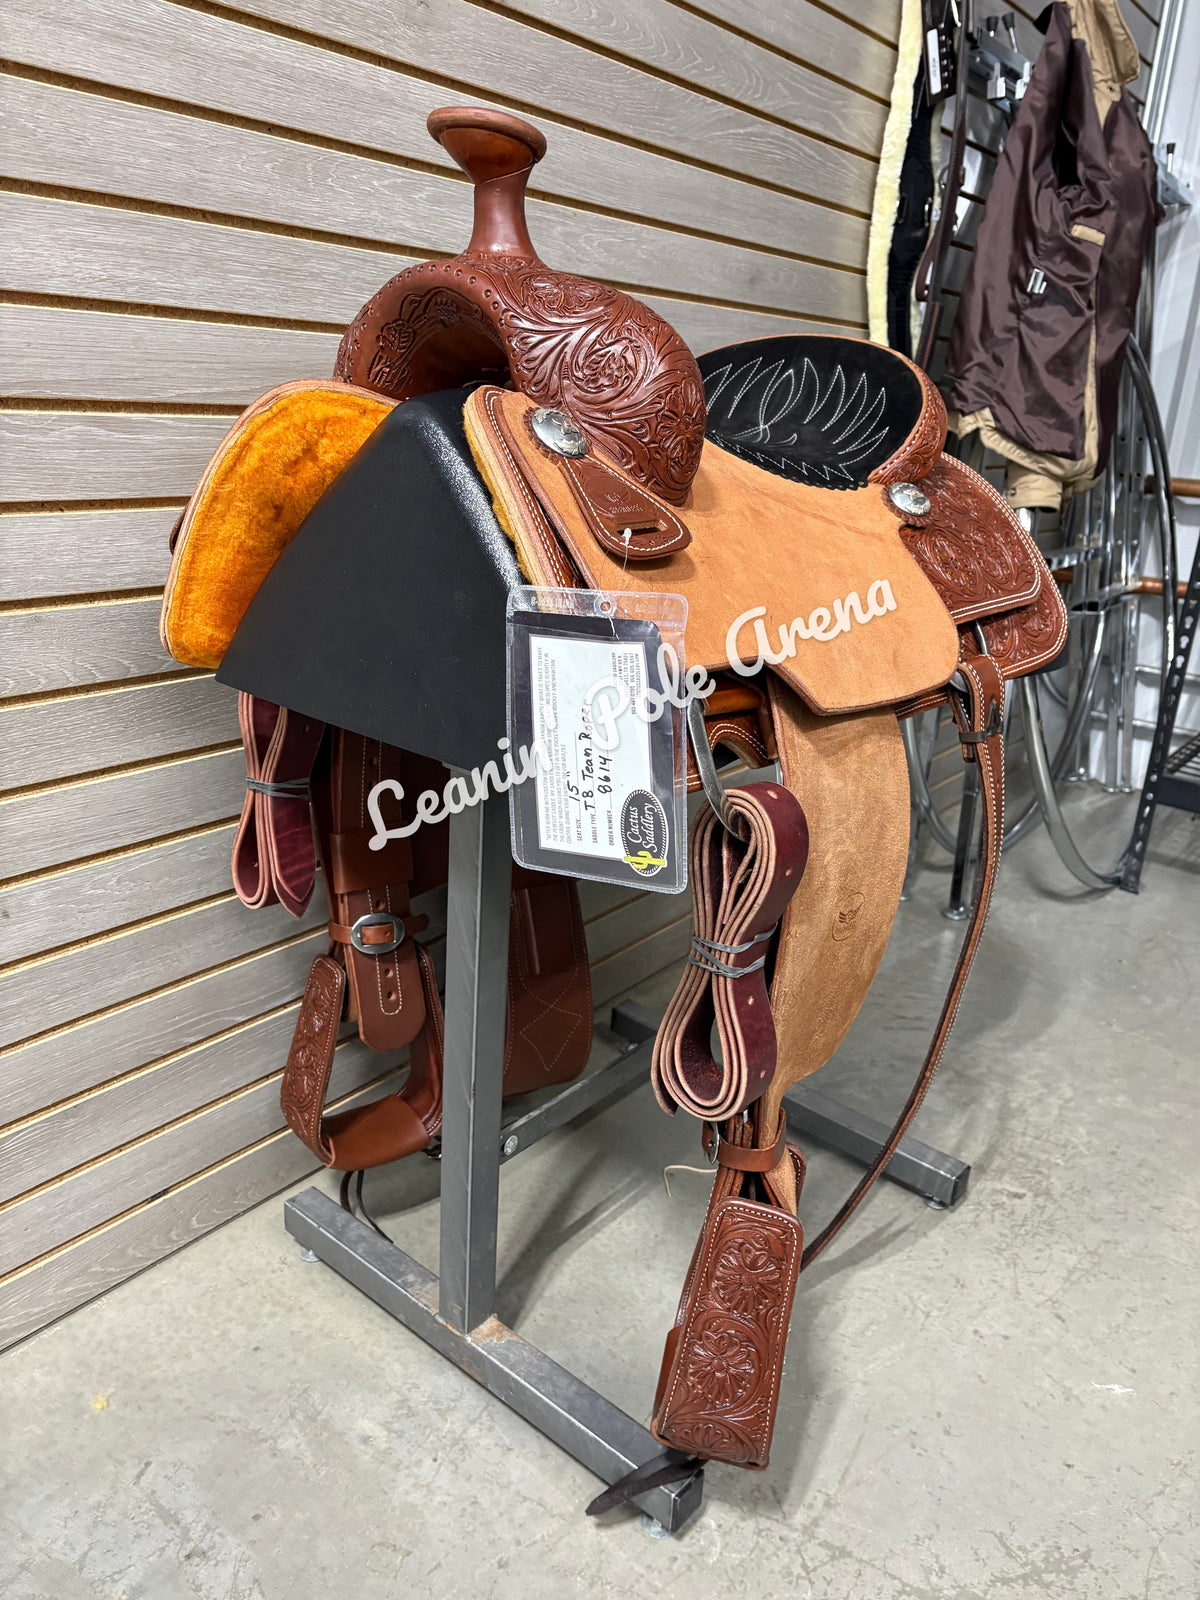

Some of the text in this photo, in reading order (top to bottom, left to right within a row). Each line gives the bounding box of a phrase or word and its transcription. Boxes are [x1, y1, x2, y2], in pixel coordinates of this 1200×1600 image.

[579, 698, 593, 741] Roper
[581, 747, 594, 781] Team
[597, 755, 613, 794] 8614
[566, 771, 580, 801] 15"
[627, 803, 657, 853] Cactus Saddlery
